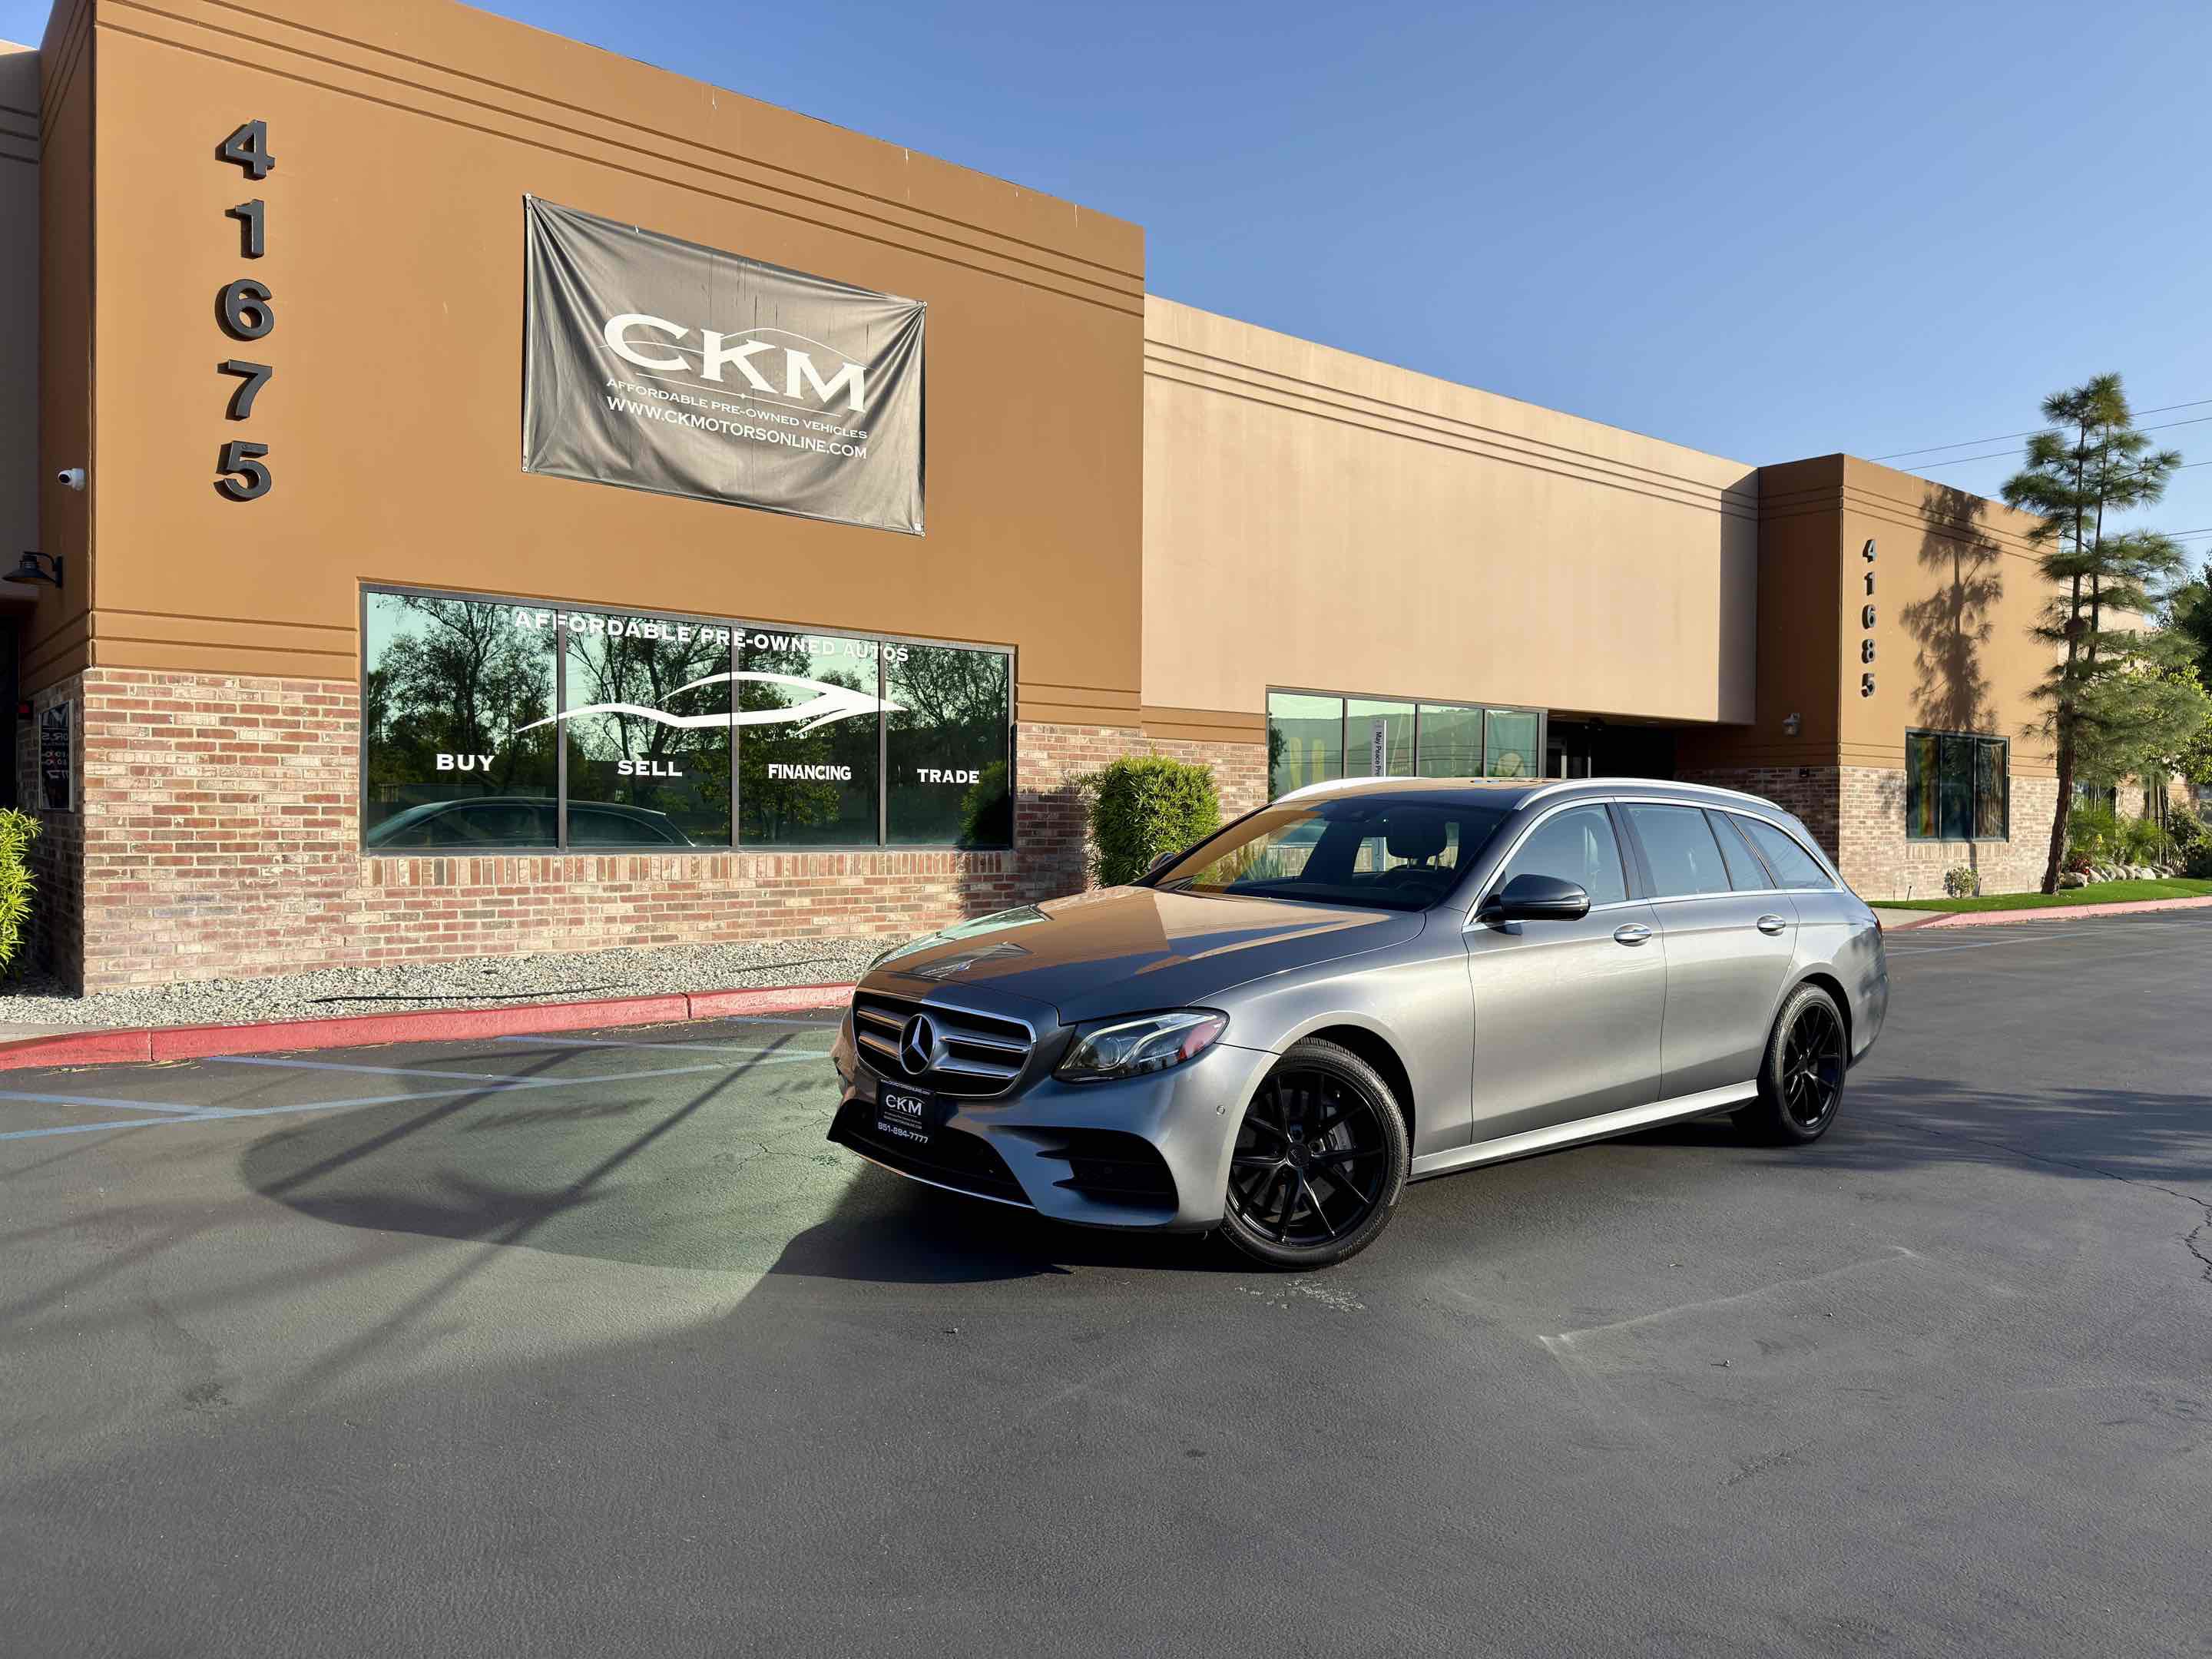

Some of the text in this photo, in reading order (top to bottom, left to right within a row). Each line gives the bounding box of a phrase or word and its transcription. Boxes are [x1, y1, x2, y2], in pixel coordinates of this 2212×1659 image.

[214, 119, 275, 502] 41675
[604, 314, 867, 413] CKM
[606, 396, 868, 459] WWW.CKMOTORSONLINE.COM
[607, 379, 868, 439] AFFORDABLE PRE-OWNED VEHICLES
[1861, 538, 1878, 698] 41685
[515, 611, 909, 663] AFFORDABLE PRE-OWNED AUTOS
[1373, 731, 1382, 745] May
[435, 753, 495, 772] BUY
[617, 760, 683, 777] SELL
[768, 763, 853, 781] FINANCING
[916, 768, 980, 784] TRADE
[886, 1094, 922, 1116] CKM
